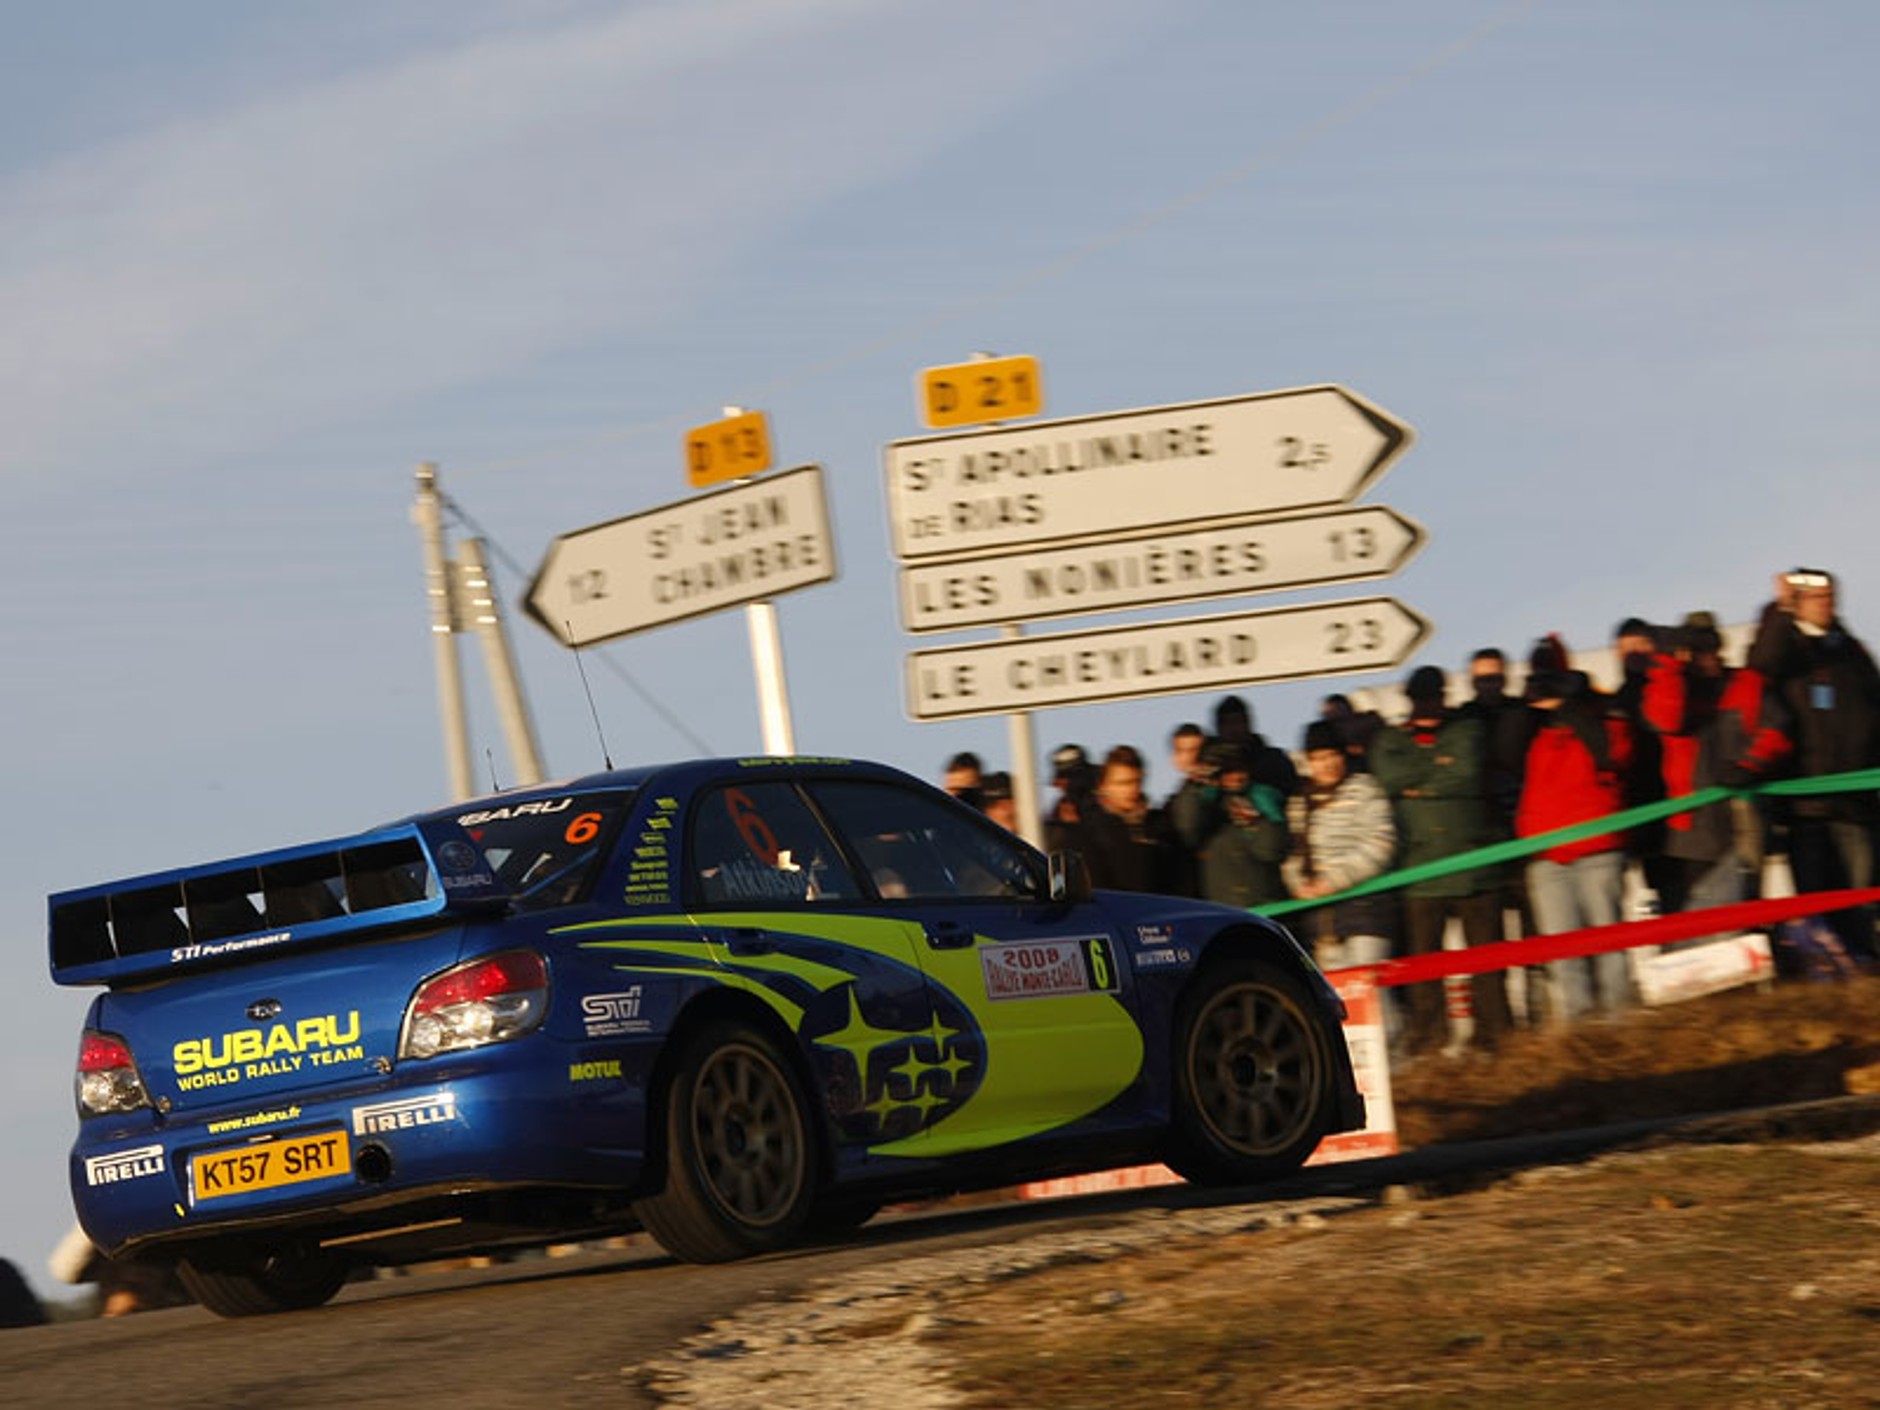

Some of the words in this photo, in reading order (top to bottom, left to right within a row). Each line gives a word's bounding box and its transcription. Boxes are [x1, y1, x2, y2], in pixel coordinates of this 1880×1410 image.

[928, 380, 960, 413] D
[974, 372, 1033, 408] 21
[688, 440, 713, 473] D
[719, 427, 761, 464] 13
[955, 424, 1215, 486] APOLLINAIRE
[698, 495, 788, 546] JEAN
[909, 515, 944, 540] DE
[949, 492, 1046, 533] RIAS
[567, 569, 609, 605] 12
[652, 534, 818, 604] CHAMBRE
[914, 573, 1000, 615] LES
[1022, 541, 1270, 601] NONIÈRES
[1328, 527, 1379, 563] 13
[921, 665, 978, 701] LE
[1006, 632, 1259, 691] CHEYLARD
[1324, 619, 1385, 656] 23
[565, 812, 602, 844] 6
[723, 787, 782, 867] 6
[202, 932, 292, 957] Performance
[1003, 947, 1060, 970] 2008
[1090, 939, 1109, 990] 6
[173, 1010, 360, 1075] SUBARU
[176, 1067, 240, 1092] WORLD
[246, 1056, 302, 1078] RALLY
[309, 1046, 363, 1066] TEAM
[570, 1060, 622, 1081] MOTUL
[207, 1106, 302, 1135] www.subaru.fr
[352, 1091, 456, 1136] PIRELLI
[85, 1144, 166, 1186] PIRELLI
[201, 1152, 271, 1192] KT57
[284, 1139, 339, 1175] SRT
